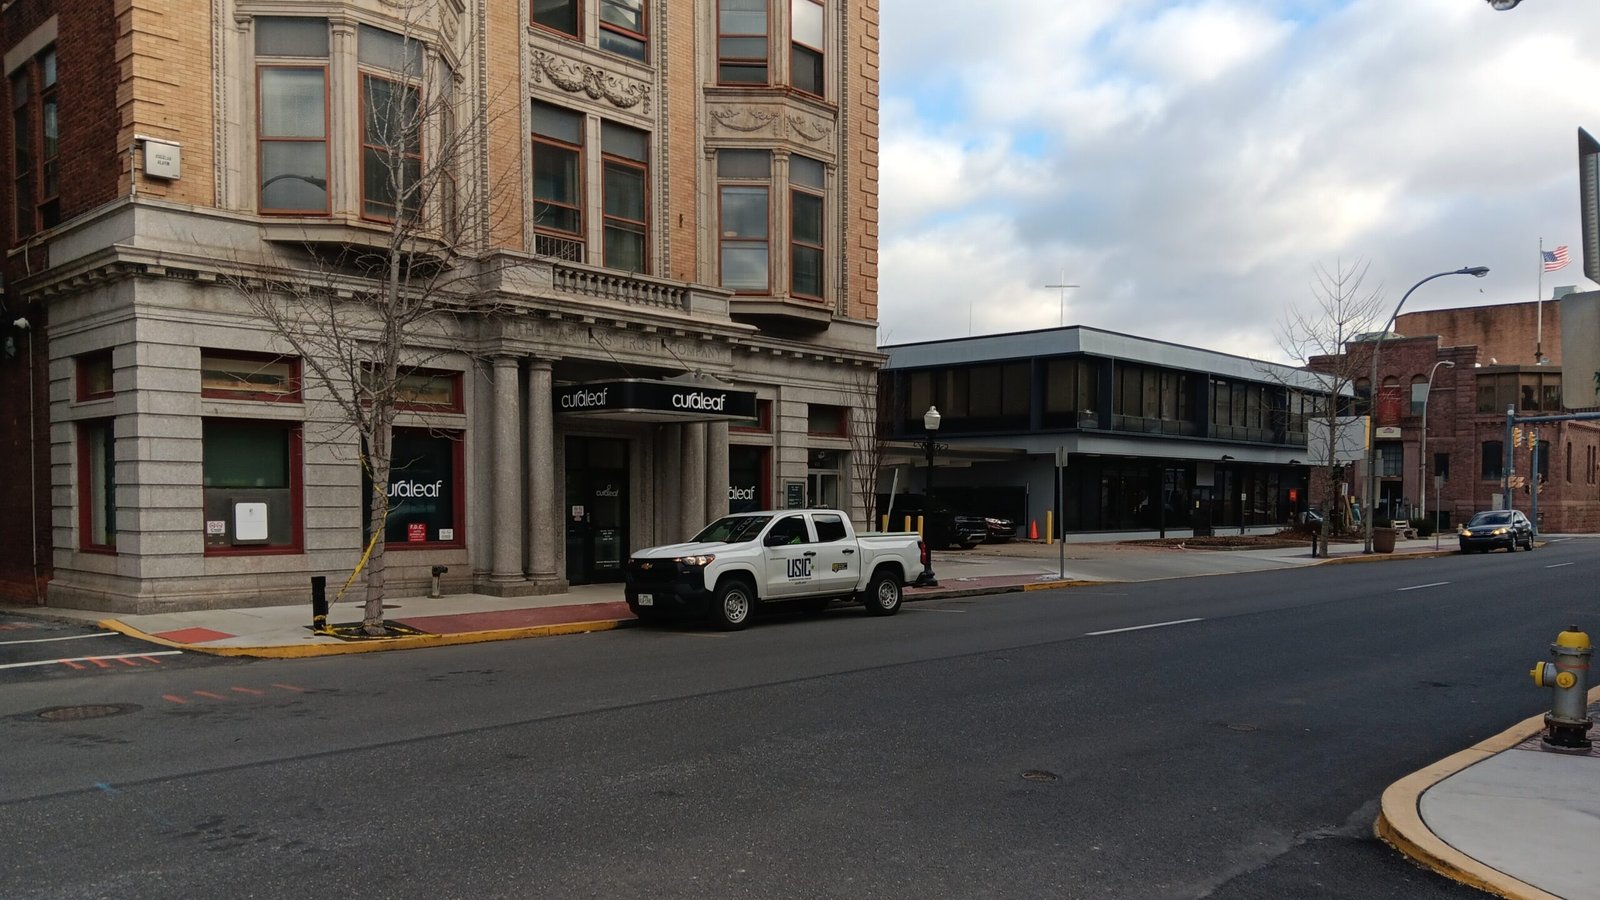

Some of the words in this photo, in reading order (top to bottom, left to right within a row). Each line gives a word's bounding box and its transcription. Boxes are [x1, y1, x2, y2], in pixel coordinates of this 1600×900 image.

[547, 326, 612, 347] ARMERS
[621, 336, 659, 353] TRUST
[561, 387, 608, 408] curaleaf
[672, 392, 726, 411] curaleaf
[387, 480, 442, 497] uraleaf
[787, 558, 811, 578] USIC
